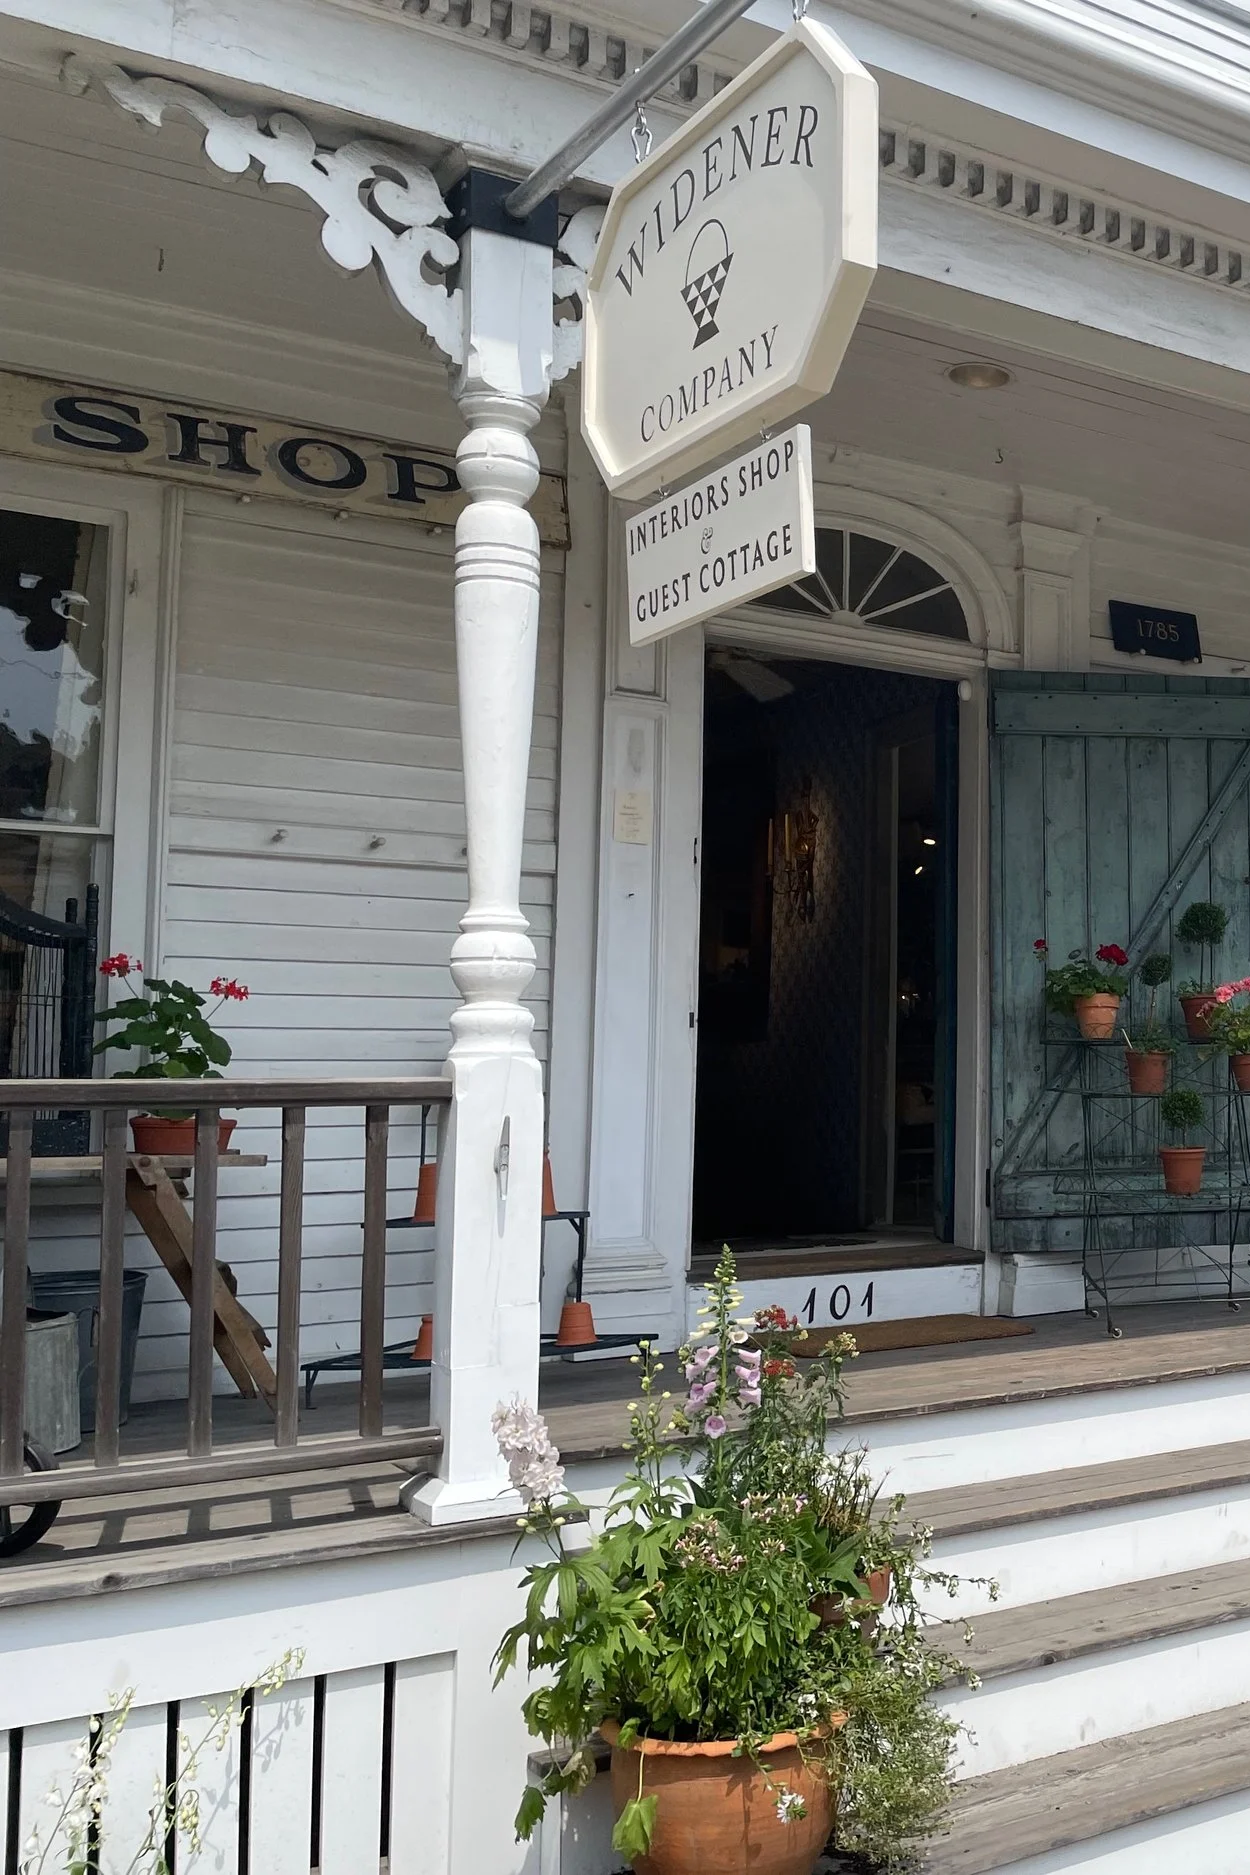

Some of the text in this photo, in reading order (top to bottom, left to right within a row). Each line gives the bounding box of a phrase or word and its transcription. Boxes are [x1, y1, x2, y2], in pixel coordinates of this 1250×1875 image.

[615, 104, 818, 297] WIDENER
[640, 324, 779, 443] COMPANY
[52, 395, 462, 504] SHOP
[630, 439, 794, 556] INTERIORS SHOP
[637, 523, 793, 622] GUEST COTTAGE
[701, 526, 714, 555] &
[1137, 618, 1180, 642] 1785
[801, 1281, 874, 1324] 101
